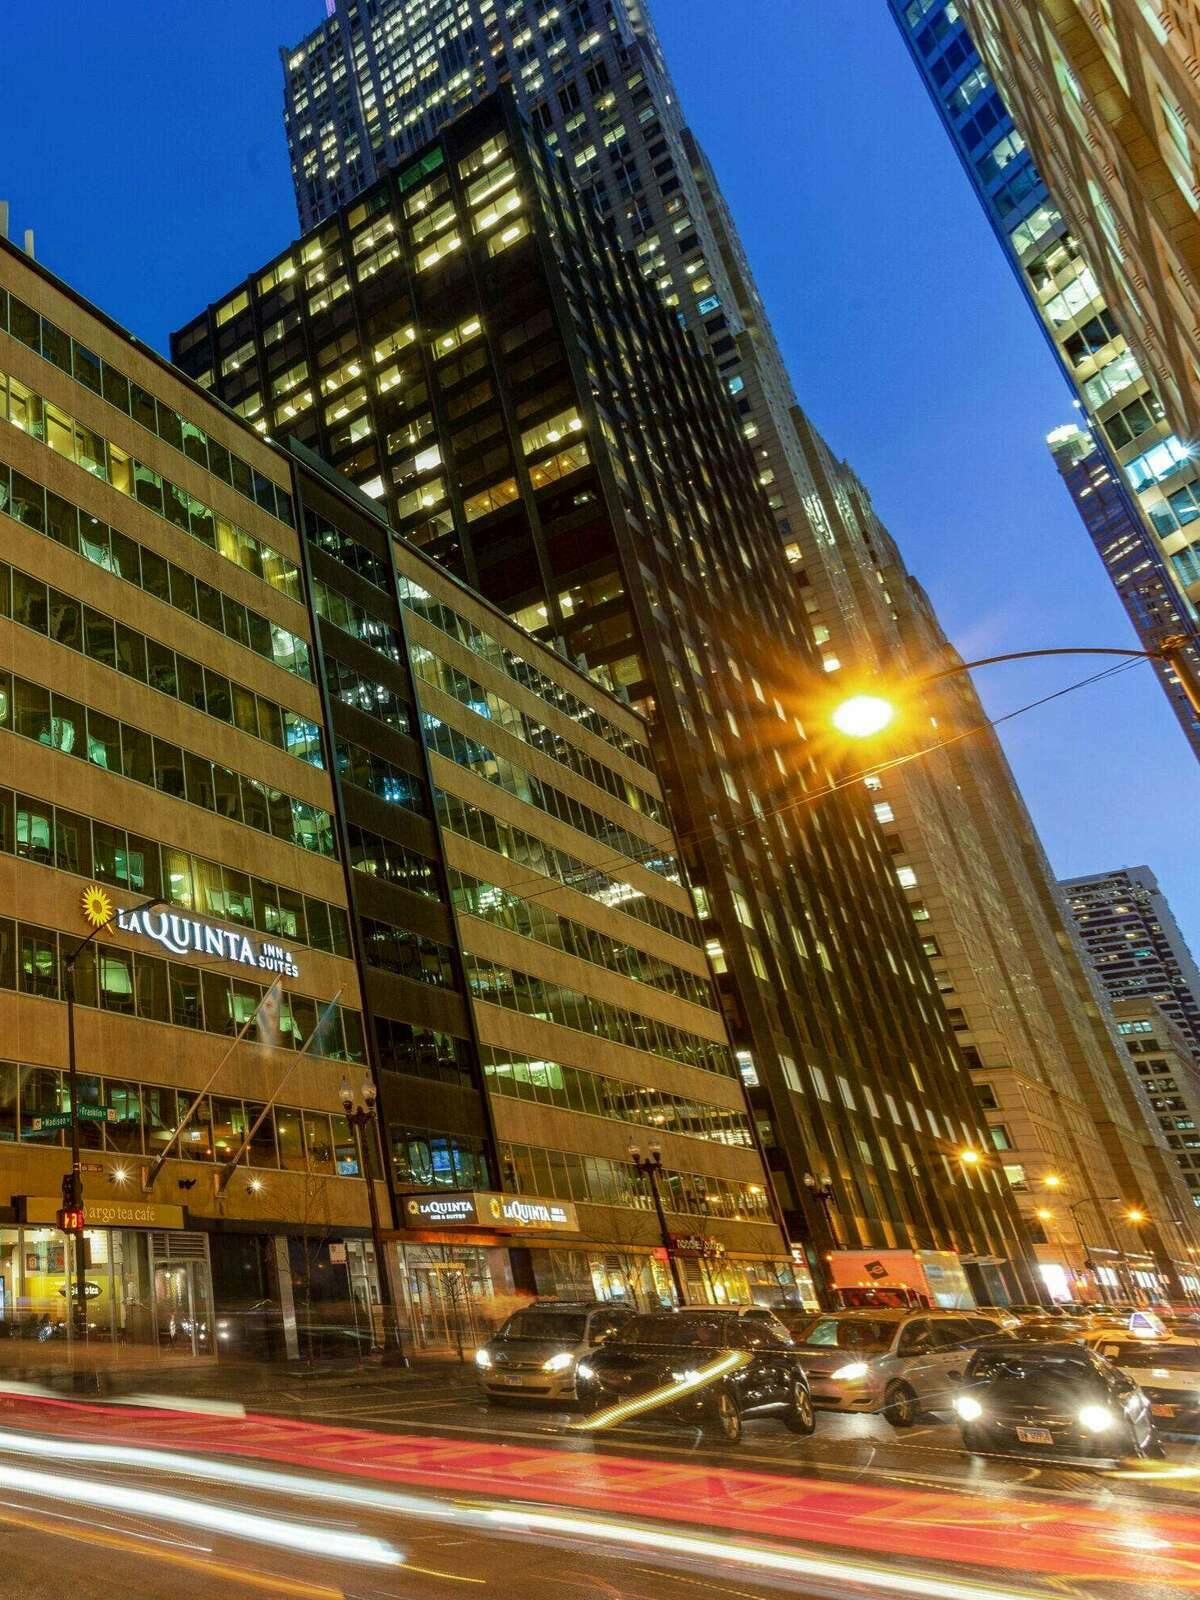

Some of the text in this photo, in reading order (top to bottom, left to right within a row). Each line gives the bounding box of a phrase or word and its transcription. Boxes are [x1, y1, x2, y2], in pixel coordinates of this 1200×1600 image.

[117, 908, 257, 967] LA QUINTA
[263, 943, 293, 963] INN &
[258, 956, 300, 978] SUITES
[81, 1106, 103, 1117] Franklin
[44, 1117, 66, 1127] Madison
[88, 1206, 116, 1223] argo
[117, 1206, 133, 1220] tea
[429, 1201, 474, 1214] QUINTA
[511, 1200, 552, 1223] QUINTA
